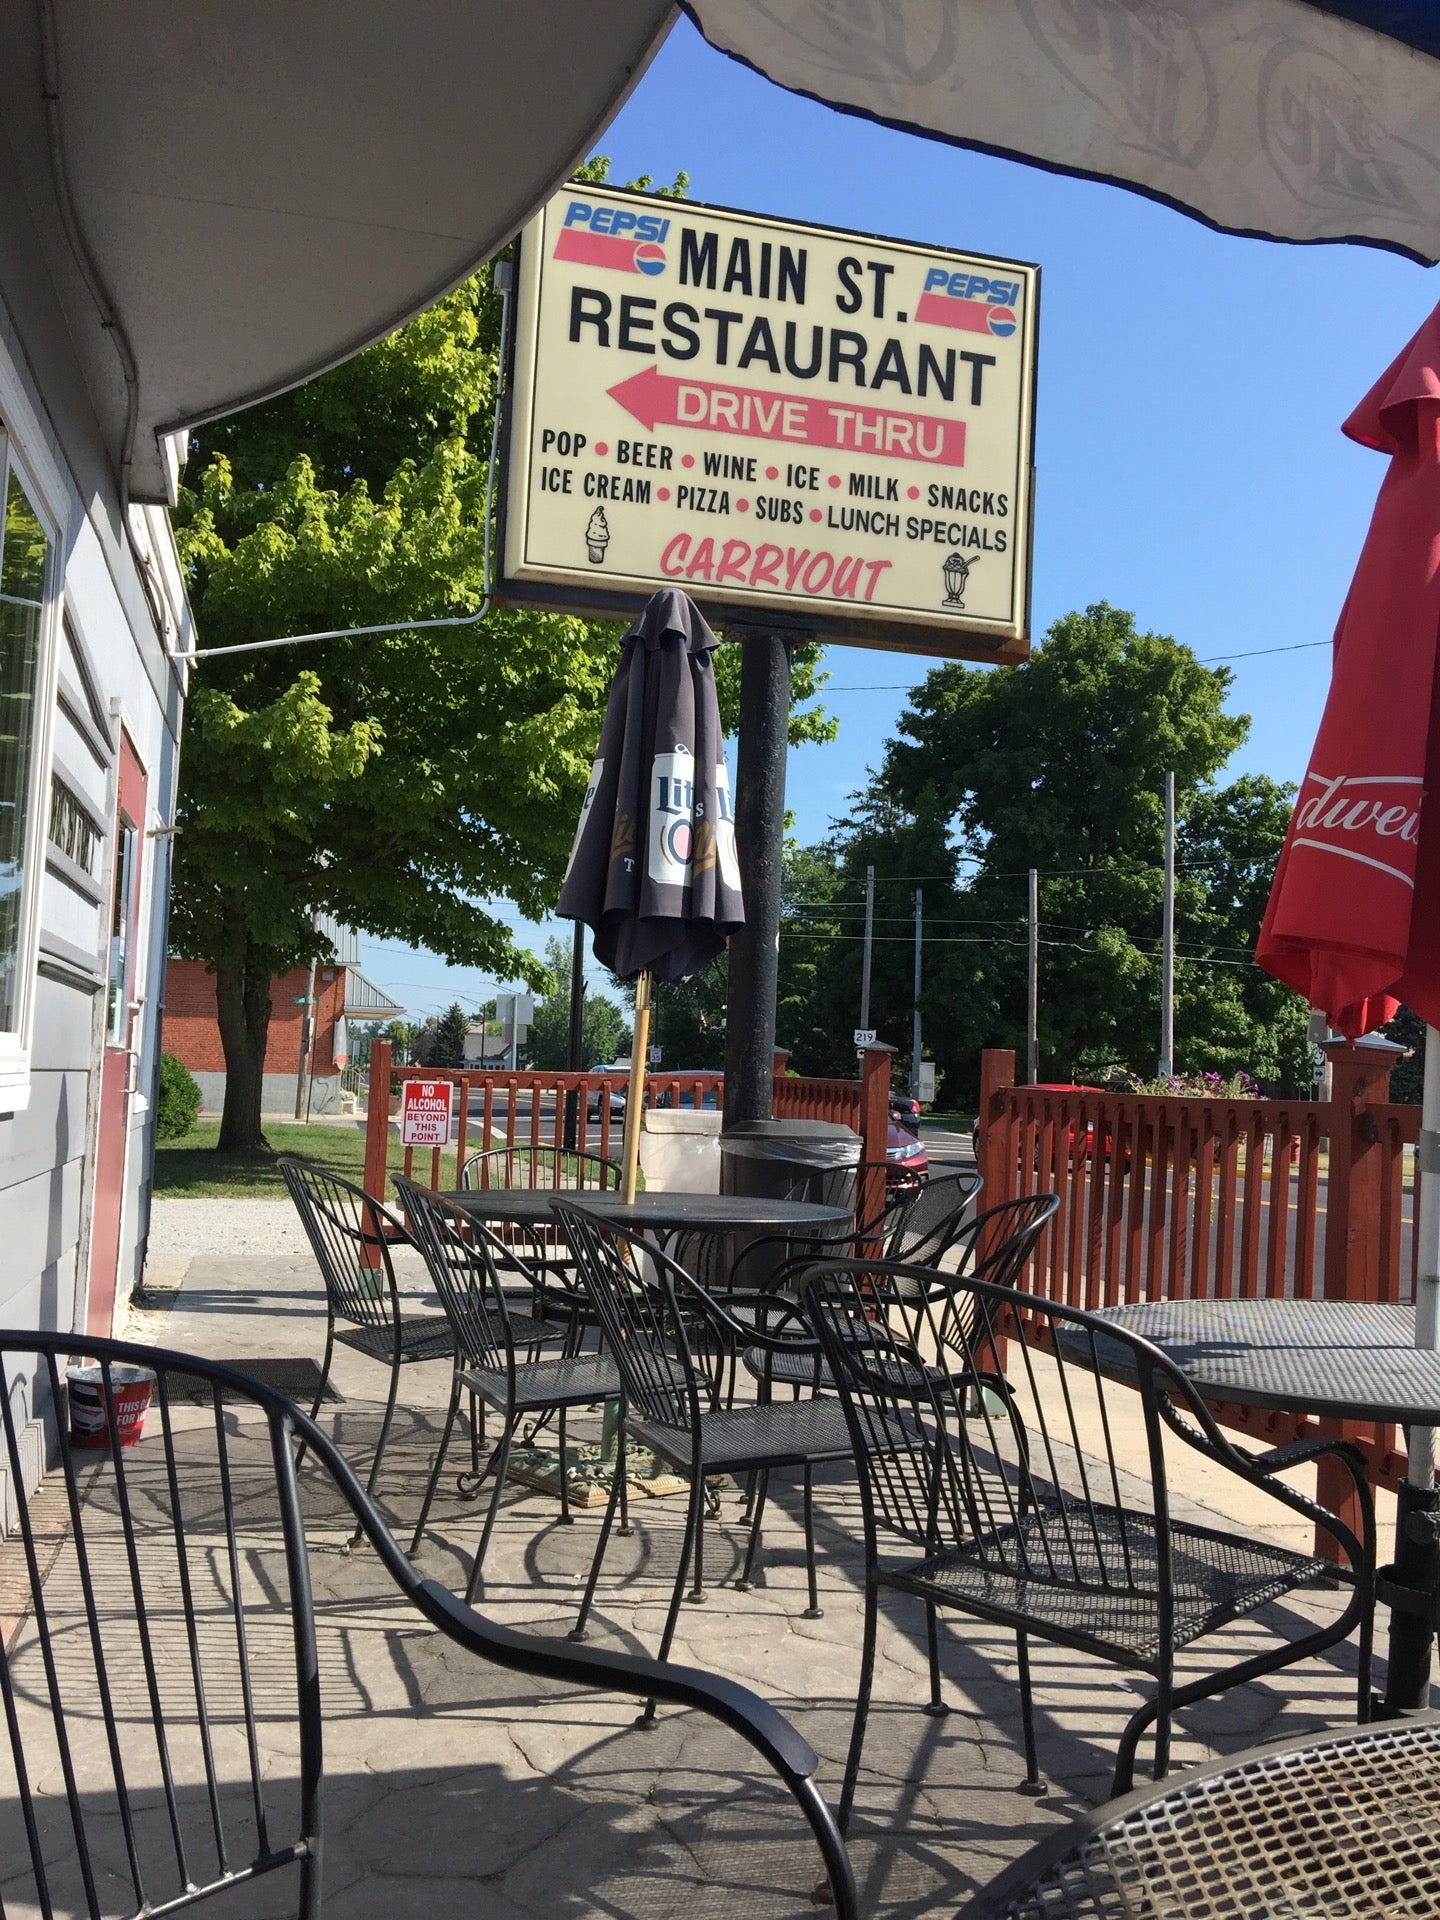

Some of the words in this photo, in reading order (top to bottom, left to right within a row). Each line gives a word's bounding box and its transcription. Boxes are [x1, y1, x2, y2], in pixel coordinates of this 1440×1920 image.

[564, 202, 670, 243] PEPSI
[679, 228, 807, 304] MAIN
[836, 256, 908, 322] ST.
[924, 268, 1020, 306] PEPSI
[568, 286, 996, 407] RESTAURANT
[676, 385, 808, 438] DRIVE
[828, 407, 944, 459] THRU
[541, 429, 587, 457] POP
[616, 439, 673, 470] BEER
[703, 451, 757, 482] WINE
[786, 464, 820, 491] ICE
[848, 472, 899, 501] MILK
[927, 483, 1009, 517] SNACKS
[541, 466, 573, 494] ICE
[583, 472, 651, 504] CREAM
[676, 485, 730, 515] PIZZA
[755, 495, 804, 525] SUBS
[827, 505, 900, 536] LUNCH
[906, 516, 1008, 552] SPECIALS
[660, 532, 893, 600] CARRYOUT
[656, 775, 694, 815] Lit
[856, 1032, 873, 1042] 219
[407, 1098, 447, 1111] ALCOHOL
[421, 1084, 435, 1097] NO
[407, 1113, 446, 1122] BEYOND
[411, 1132, 440, 1141] POINT
[415, 1123, 437, 1131] THIS
[116, 1413, 136, 1426] FOR
[118, 1401, 140, 1413] THIS
